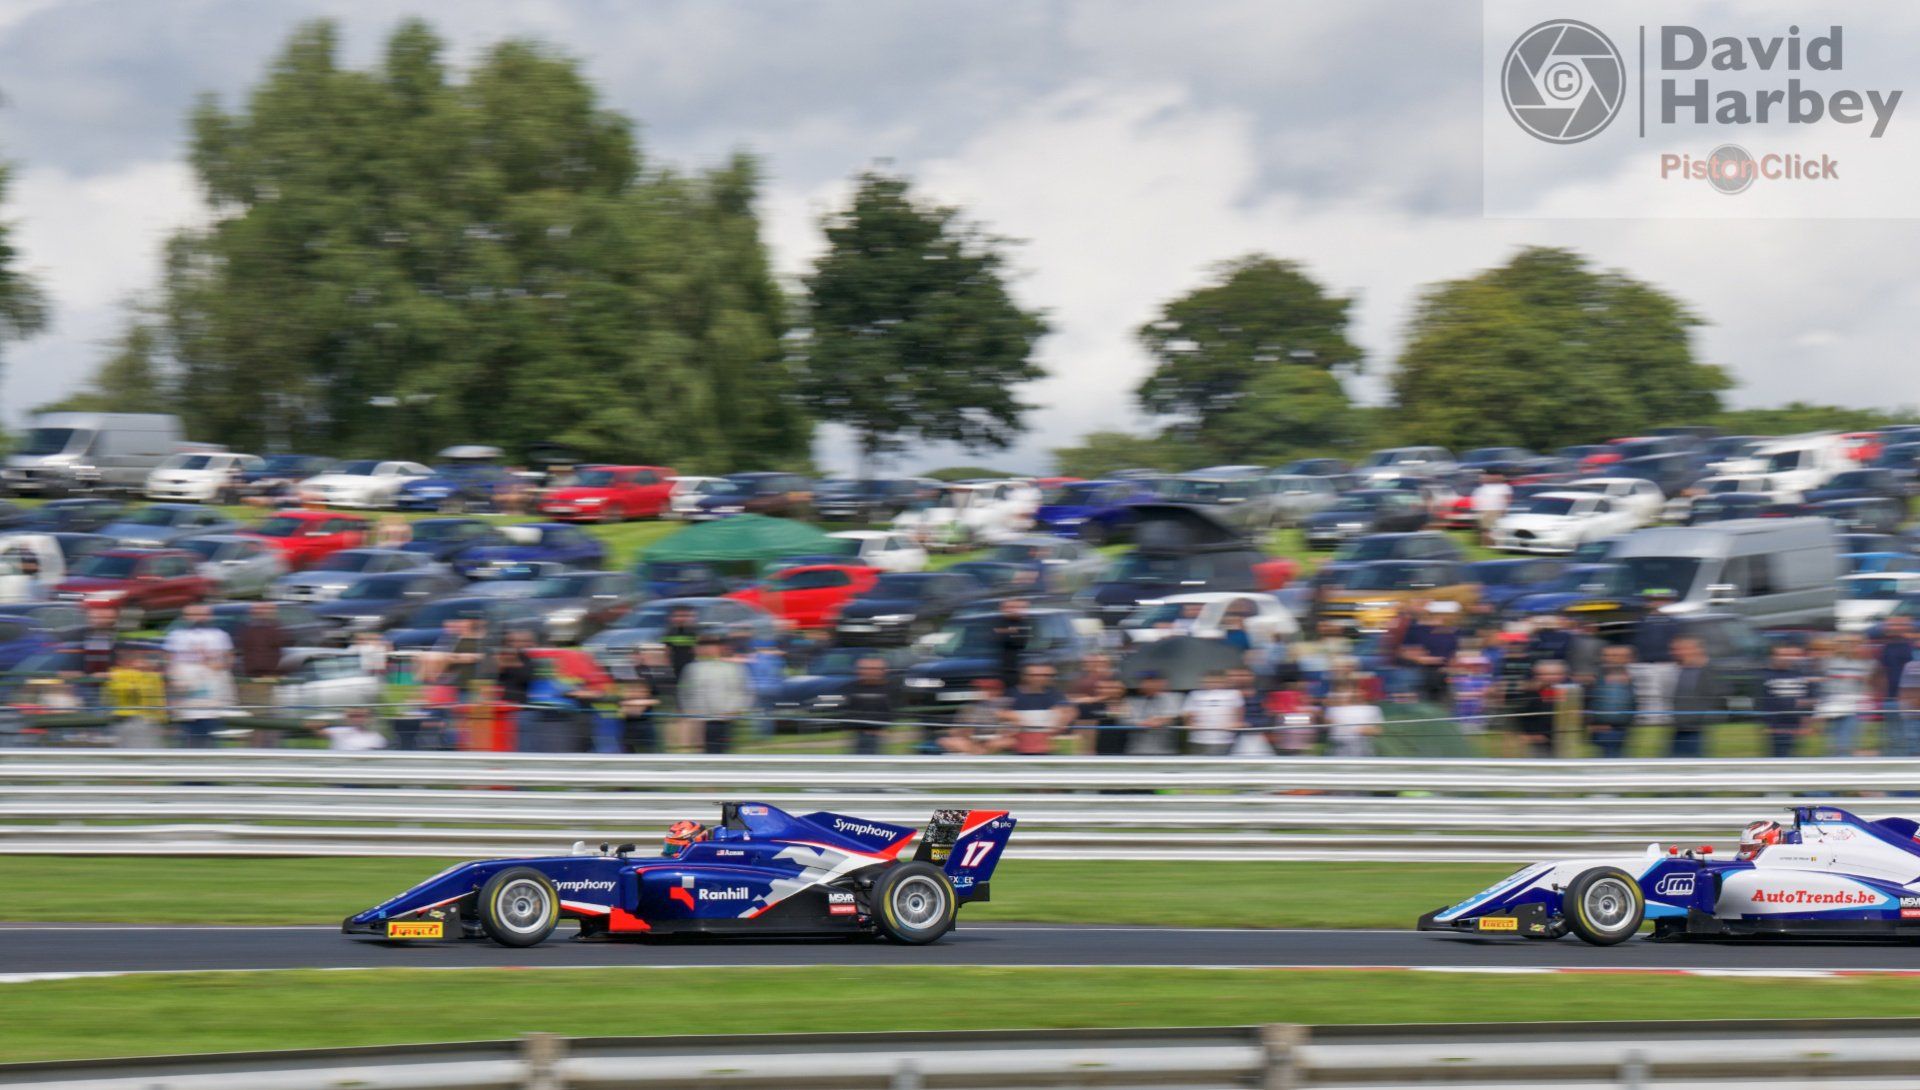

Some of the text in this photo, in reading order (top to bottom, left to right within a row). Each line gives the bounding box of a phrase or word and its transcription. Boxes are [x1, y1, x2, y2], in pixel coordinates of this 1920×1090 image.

[833, 818, 898, 842] Symphony
[960, 840, 996, 868] 17
[551, 879, 616, 893] ymphony
[698, 887, 749, 900] Ranhill
[828, 893, 856, 903] MSVR
[1751, 889, 1877, 904] AutoTrends.be
[391, 924, 441, 936] PIRELLI
